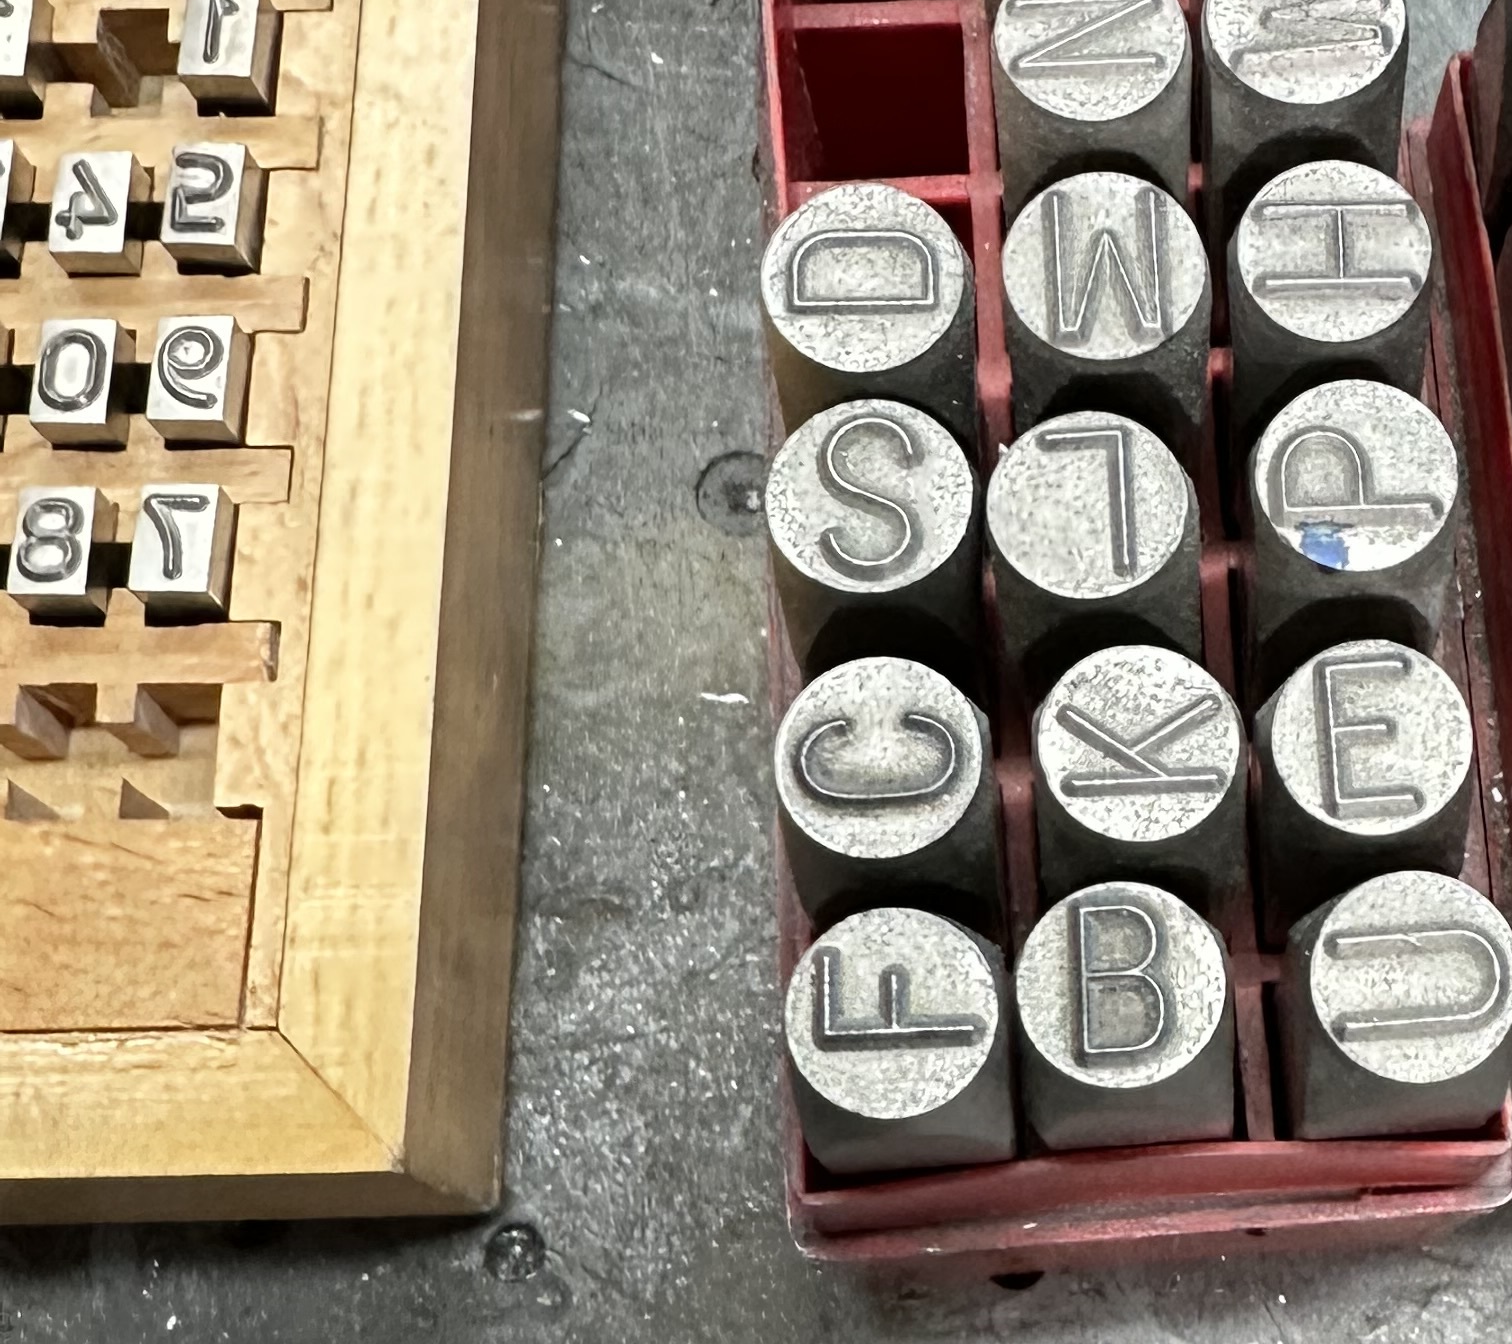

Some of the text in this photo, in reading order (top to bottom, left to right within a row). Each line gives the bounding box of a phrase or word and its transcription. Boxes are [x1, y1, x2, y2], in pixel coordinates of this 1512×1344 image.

[785, 228, 939, 313] D
[1251, 198, 1423, 294] H
[817, 412, 925, 581] S
[1270, 425, 1444, 522] P
[795, 709, 964, 806] C
[1055, 692, 1227, 798] K
[1313, 655, 1427, 820] E
[814, 943, 989, 1052] F
[1068, 899, 1169, 1068] B
